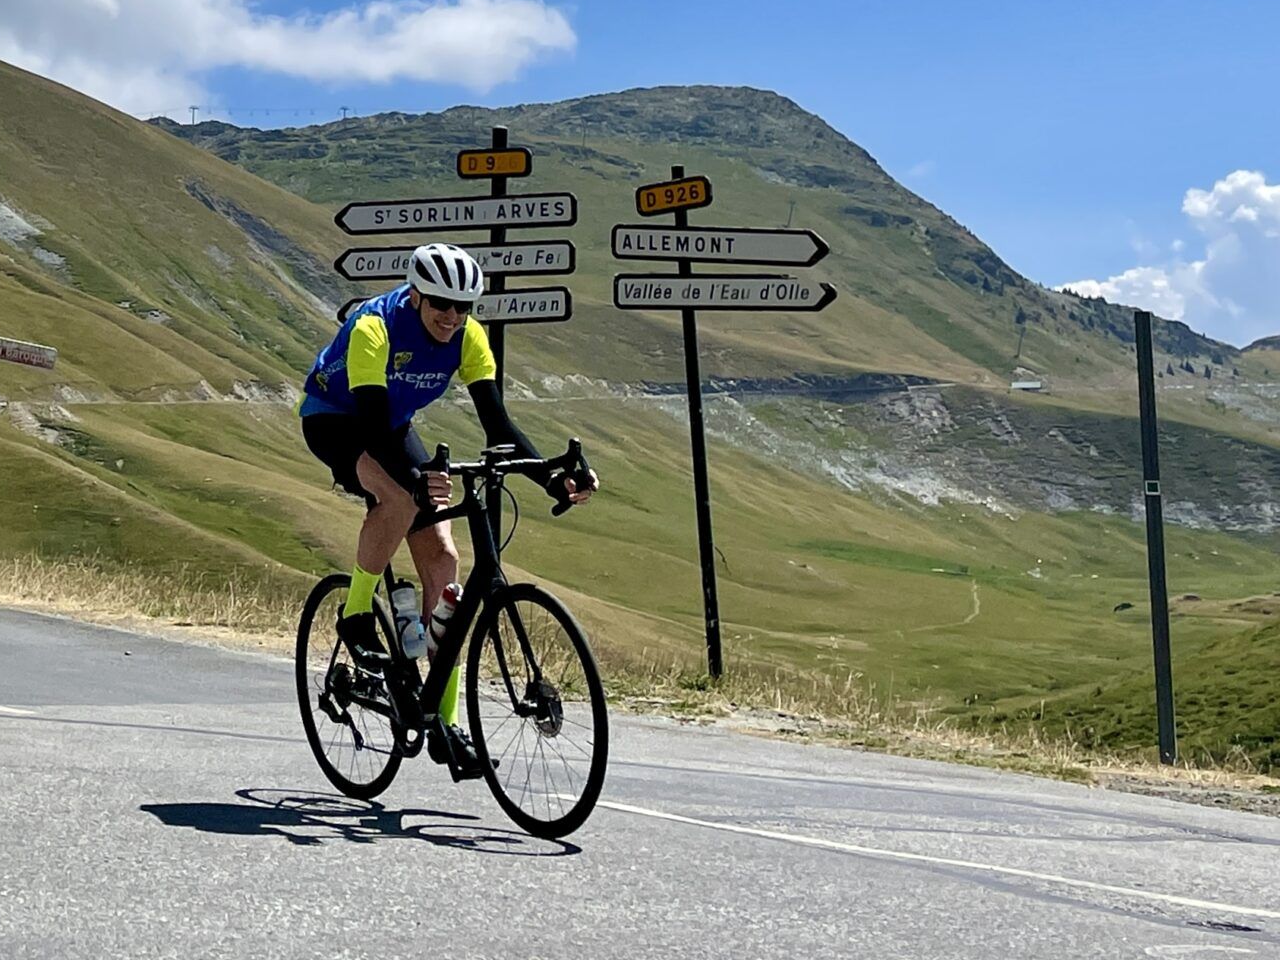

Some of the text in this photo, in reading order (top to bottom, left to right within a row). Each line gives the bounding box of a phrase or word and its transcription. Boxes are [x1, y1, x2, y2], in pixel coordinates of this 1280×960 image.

[468, 156, 477, 171] D
[646, 185, 700, 207] D 926
[398, 205, 474, 223] SORLIN
[496, 201, 565, 219] ARVES
[622, 234, 735, 254] ALLEMONT
[355, 257, 382, 272] Col
[391, 254, 410, 270] de
[502, 250, 523, 266] de
[623, 283, 810, 300] Vallée de l'Eau d'Olle
[496, 298, 560, 315] l'Arvan
